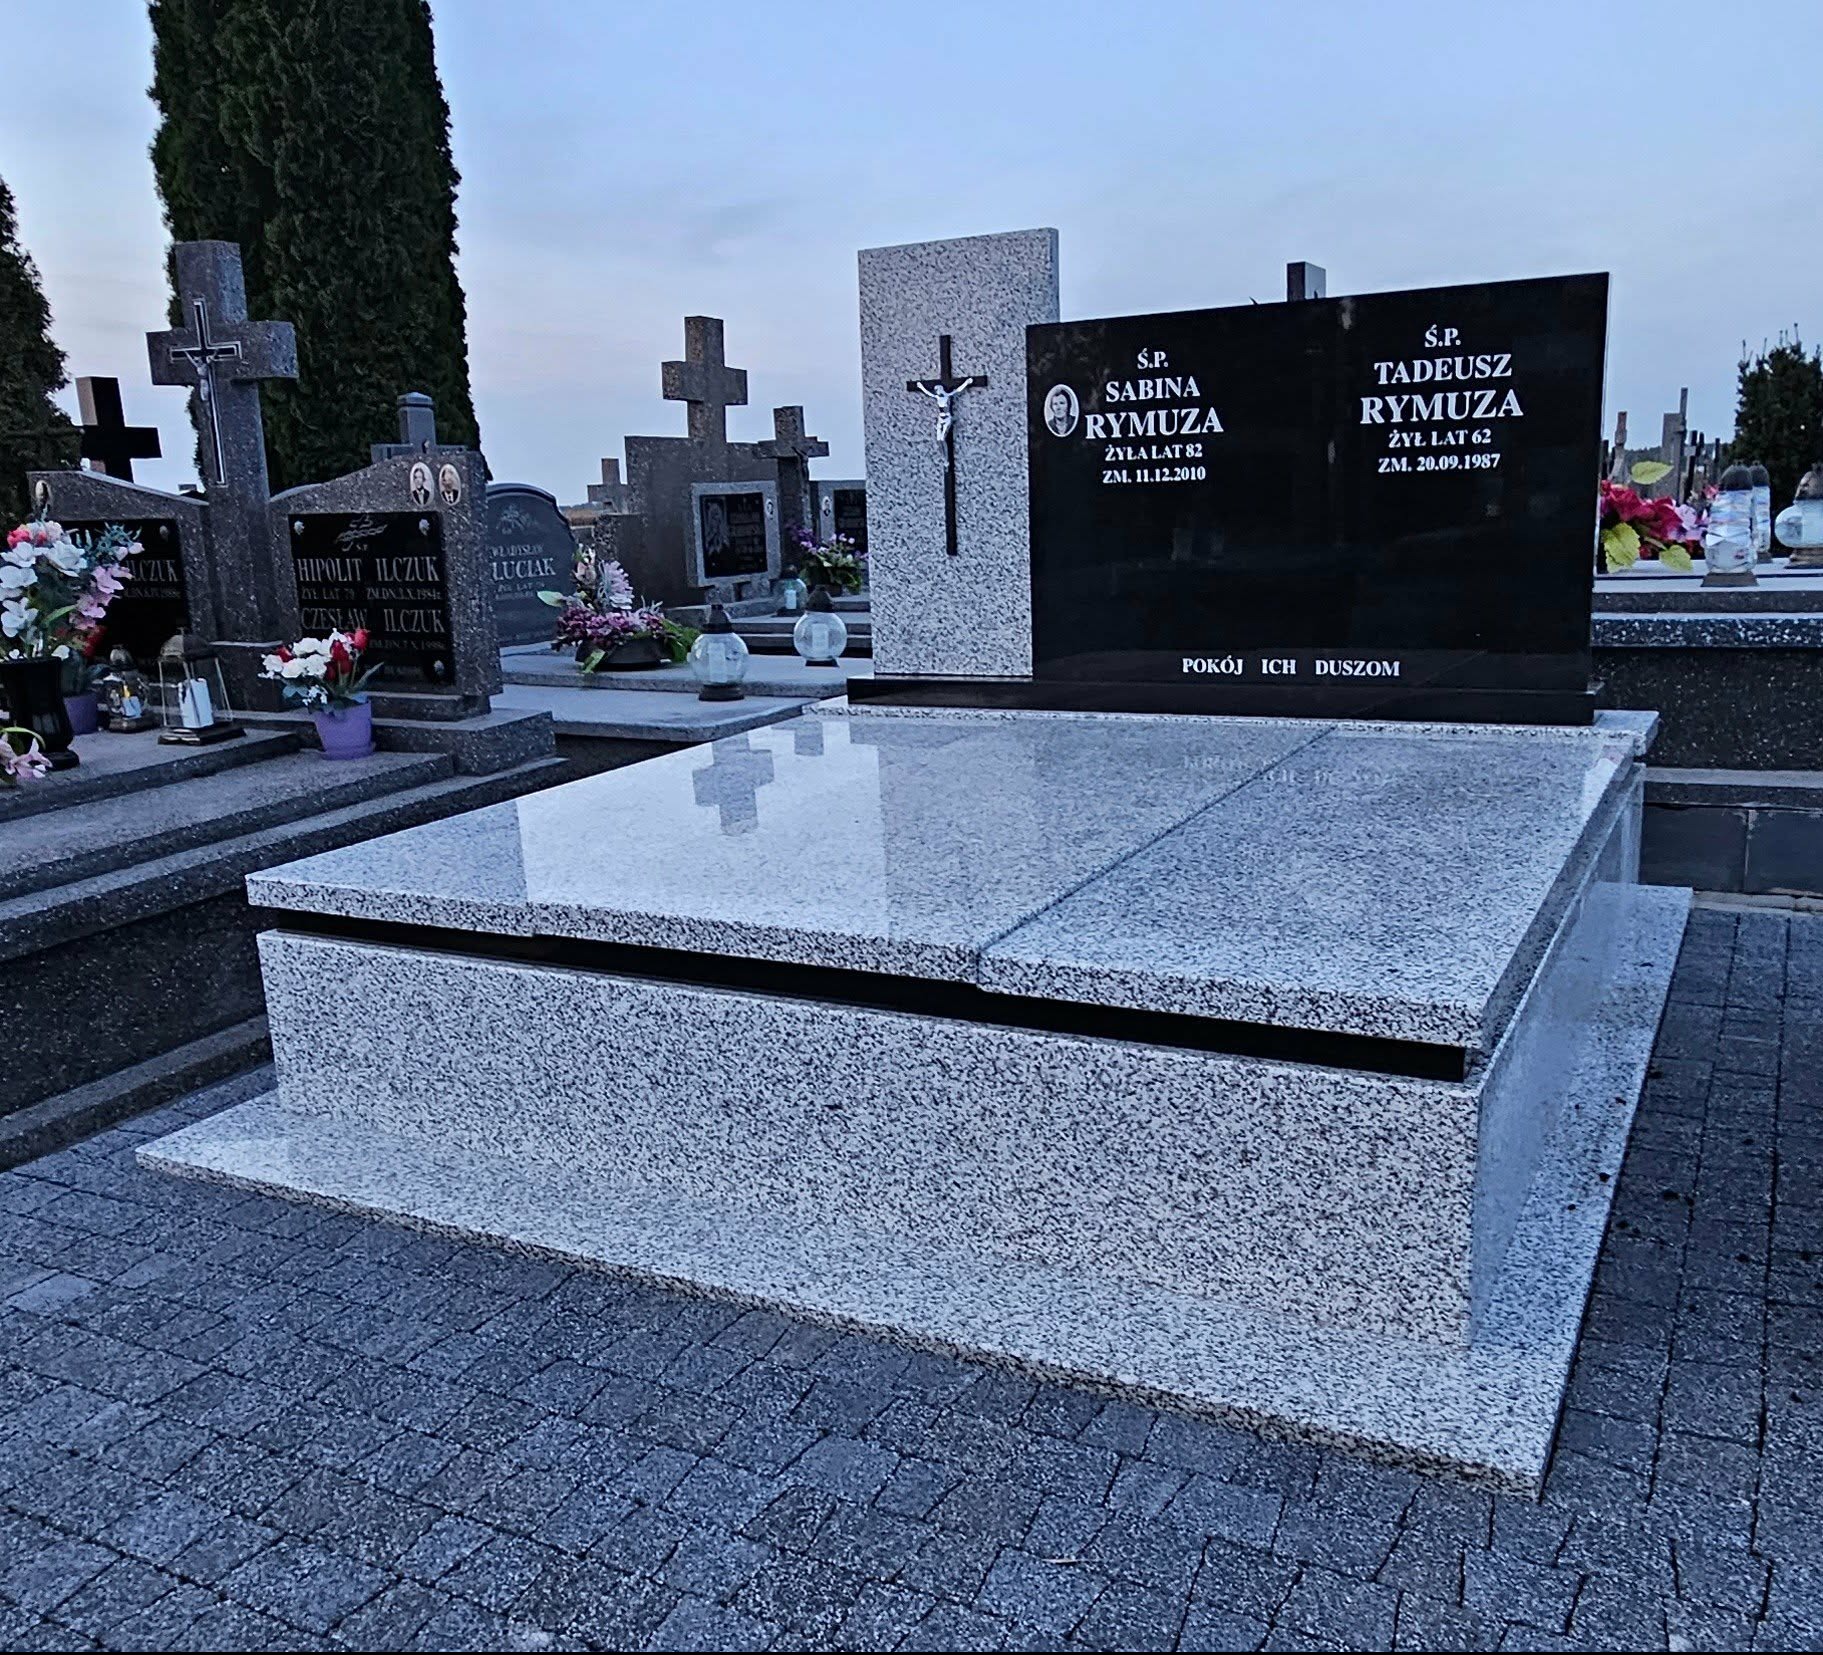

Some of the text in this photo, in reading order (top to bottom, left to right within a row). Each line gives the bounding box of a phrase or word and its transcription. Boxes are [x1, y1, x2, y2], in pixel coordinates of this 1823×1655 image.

[1424, 324, 1461, 347] Ś.P.
[1137, 348, 1169, 369] Ś.P.
[1374, 354, 1512, 384] TADEUSZ
[1106, 376, 1200, 402] SABINA
[1360, 389, 1523, 424] RYMUZA
[1085, 407, 1224, 439] RYMUZA
[1389, 429, 1491, 448] ŻYŁ LAT 62
[1105, 443, 1203, 461] ŻYŁA LAT 82
[1378, 453, 1500, 473] ZM. 20.09.1987
[1102, 466, 1206, 483] ZM. 11.12.2010
[298, 557, 440, 582] HIPOLIT ILCZUK
[384, 608, 445, 632] ILCZUK
[1182, 655, 1400, 676] POKÓJ ICH DUSZOM
